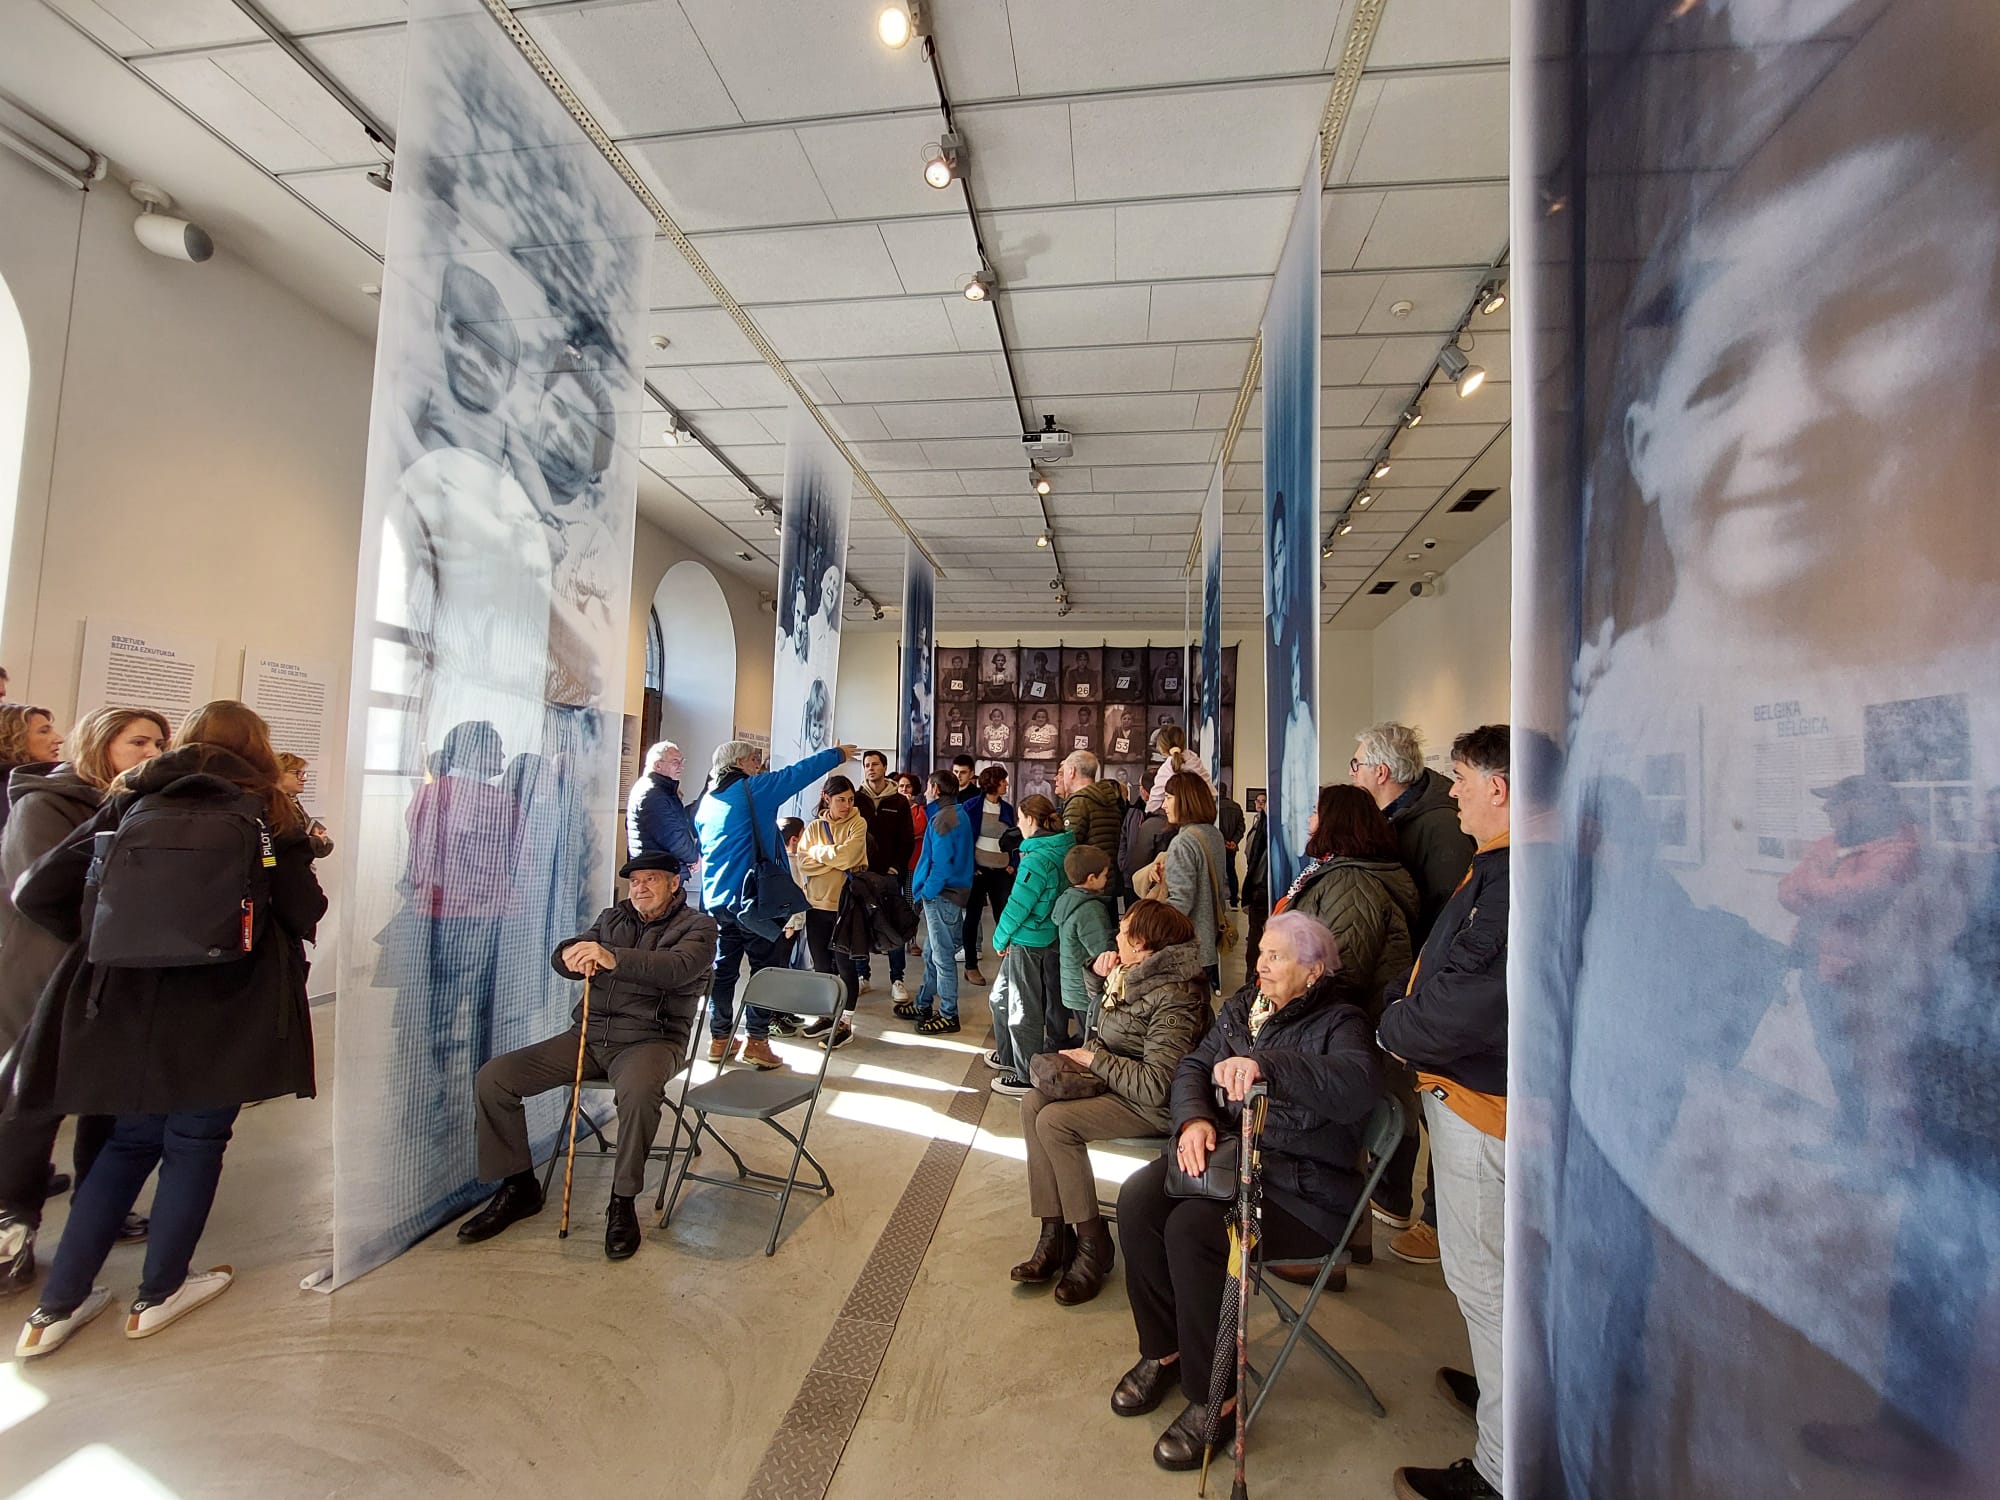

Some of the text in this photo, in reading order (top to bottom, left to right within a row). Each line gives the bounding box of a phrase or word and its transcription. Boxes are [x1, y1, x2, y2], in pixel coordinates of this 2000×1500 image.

[111, 635, 145, 646] OBJETUEN
[111, 642, 139, 652] BIZITZA
[280, 663, 300, 671] SECRETA
[287, 670, 308, 678] OBJETOS
[1117, 679, 1129, 687] 77
[1077, 686, 1089, 695] 26
[1753, 701, 1801, 721] BELGIKA
[1777, 717, 1829, 737] BELGICA
[950, 735, 961, 743] 56
[1075, 738, 1088, 747] 75
[990, 742, 1002, 750] 33
[1116, 740, 1129, 750] 53
[260, 832, 272, 856] PILOT
